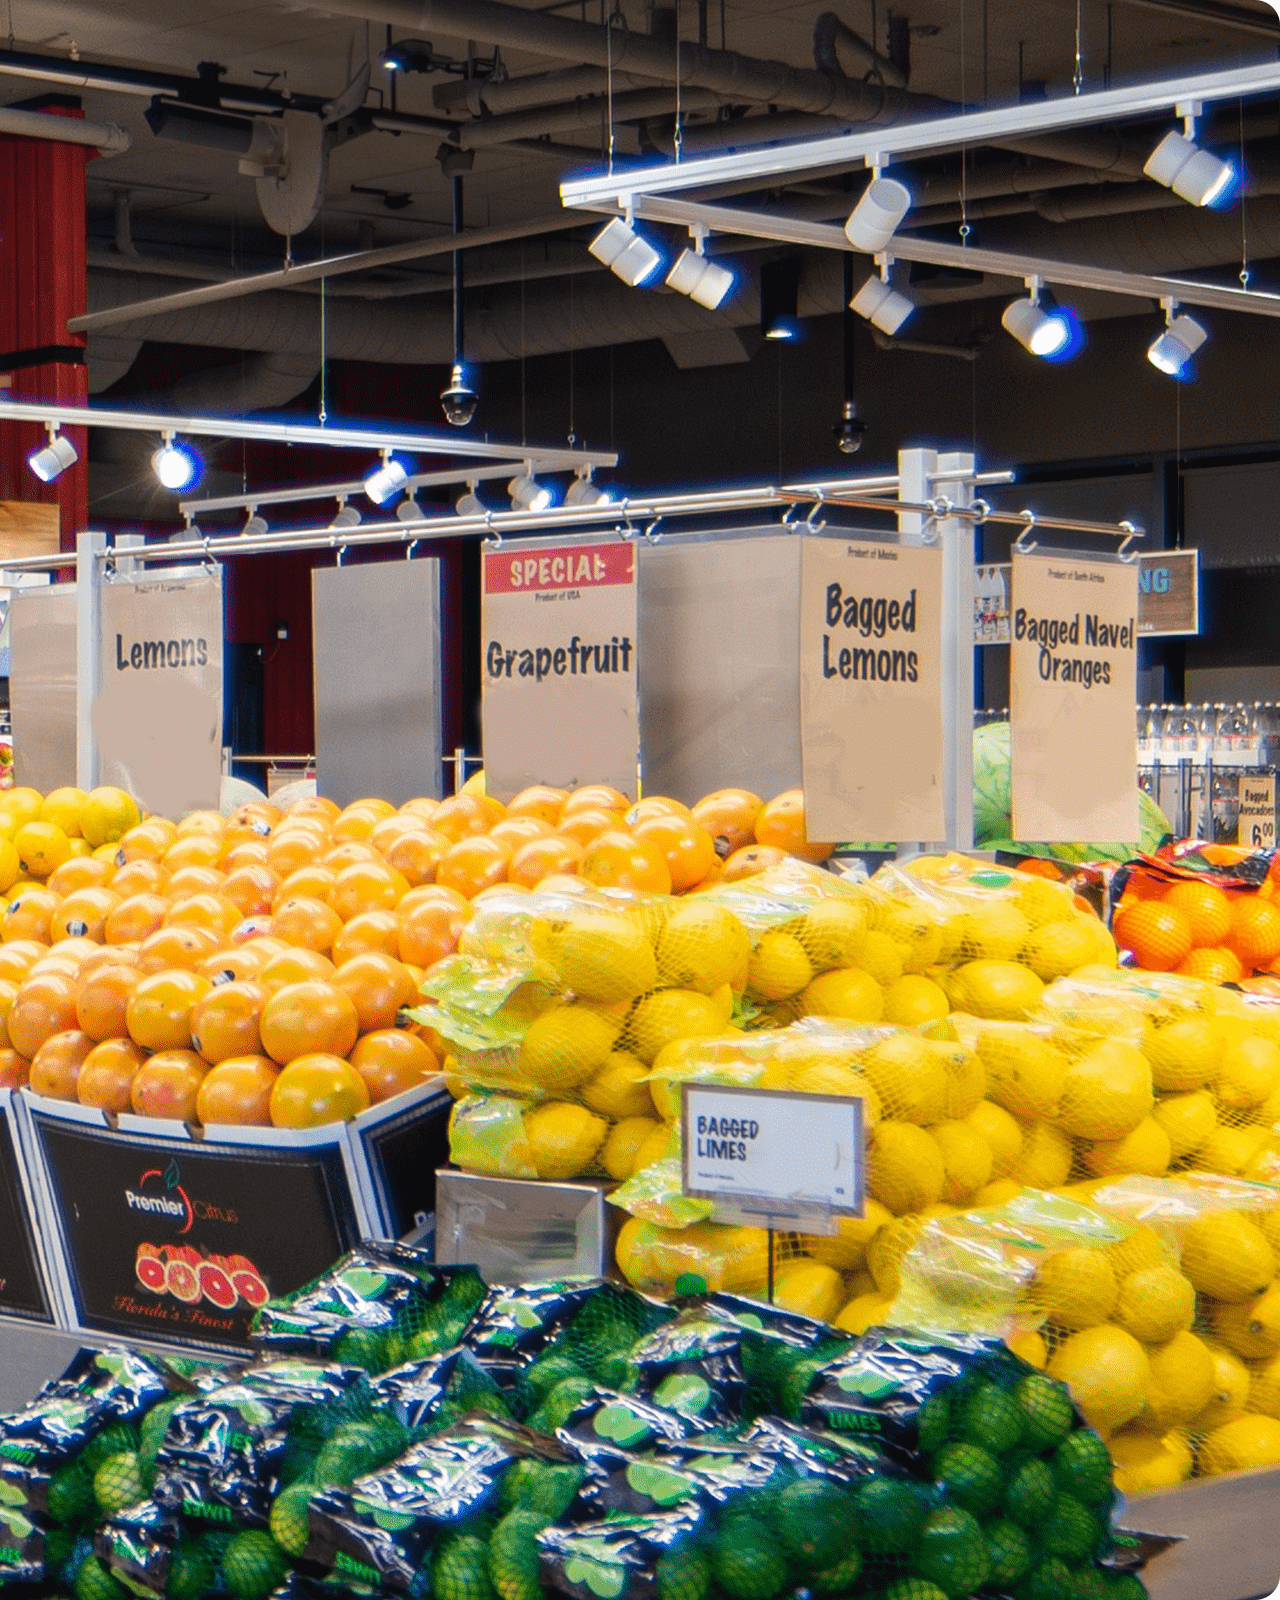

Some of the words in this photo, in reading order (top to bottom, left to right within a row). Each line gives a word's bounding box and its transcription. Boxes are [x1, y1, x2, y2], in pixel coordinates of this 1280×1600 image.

[510, 552, 607, 587] SPECIAL
[826, 582, 917, 638] Bagged
[1015, 608, 1080, 649] Bagged
[1085, 614, 1134, 649] Navel
[116, 633, 208, 671] Lemons
[487, 636, 632, 682] Grapefruit
[823, 634, 918, 683] Lemons
[1039, 644, 1111, 689] Oranges
[1244, 789, 1269, 803] Bagged
[697, 1115, 760, 1140] BAGGED
[697, 1137, 747, 1162] LIMES
[125, 1190, 185, 1217] Premier
[112, 1294, 180, 1321] Florida's
[183, 1308, 235, 1330] Finest
[829, 1411, 881, 1431] LIMES
